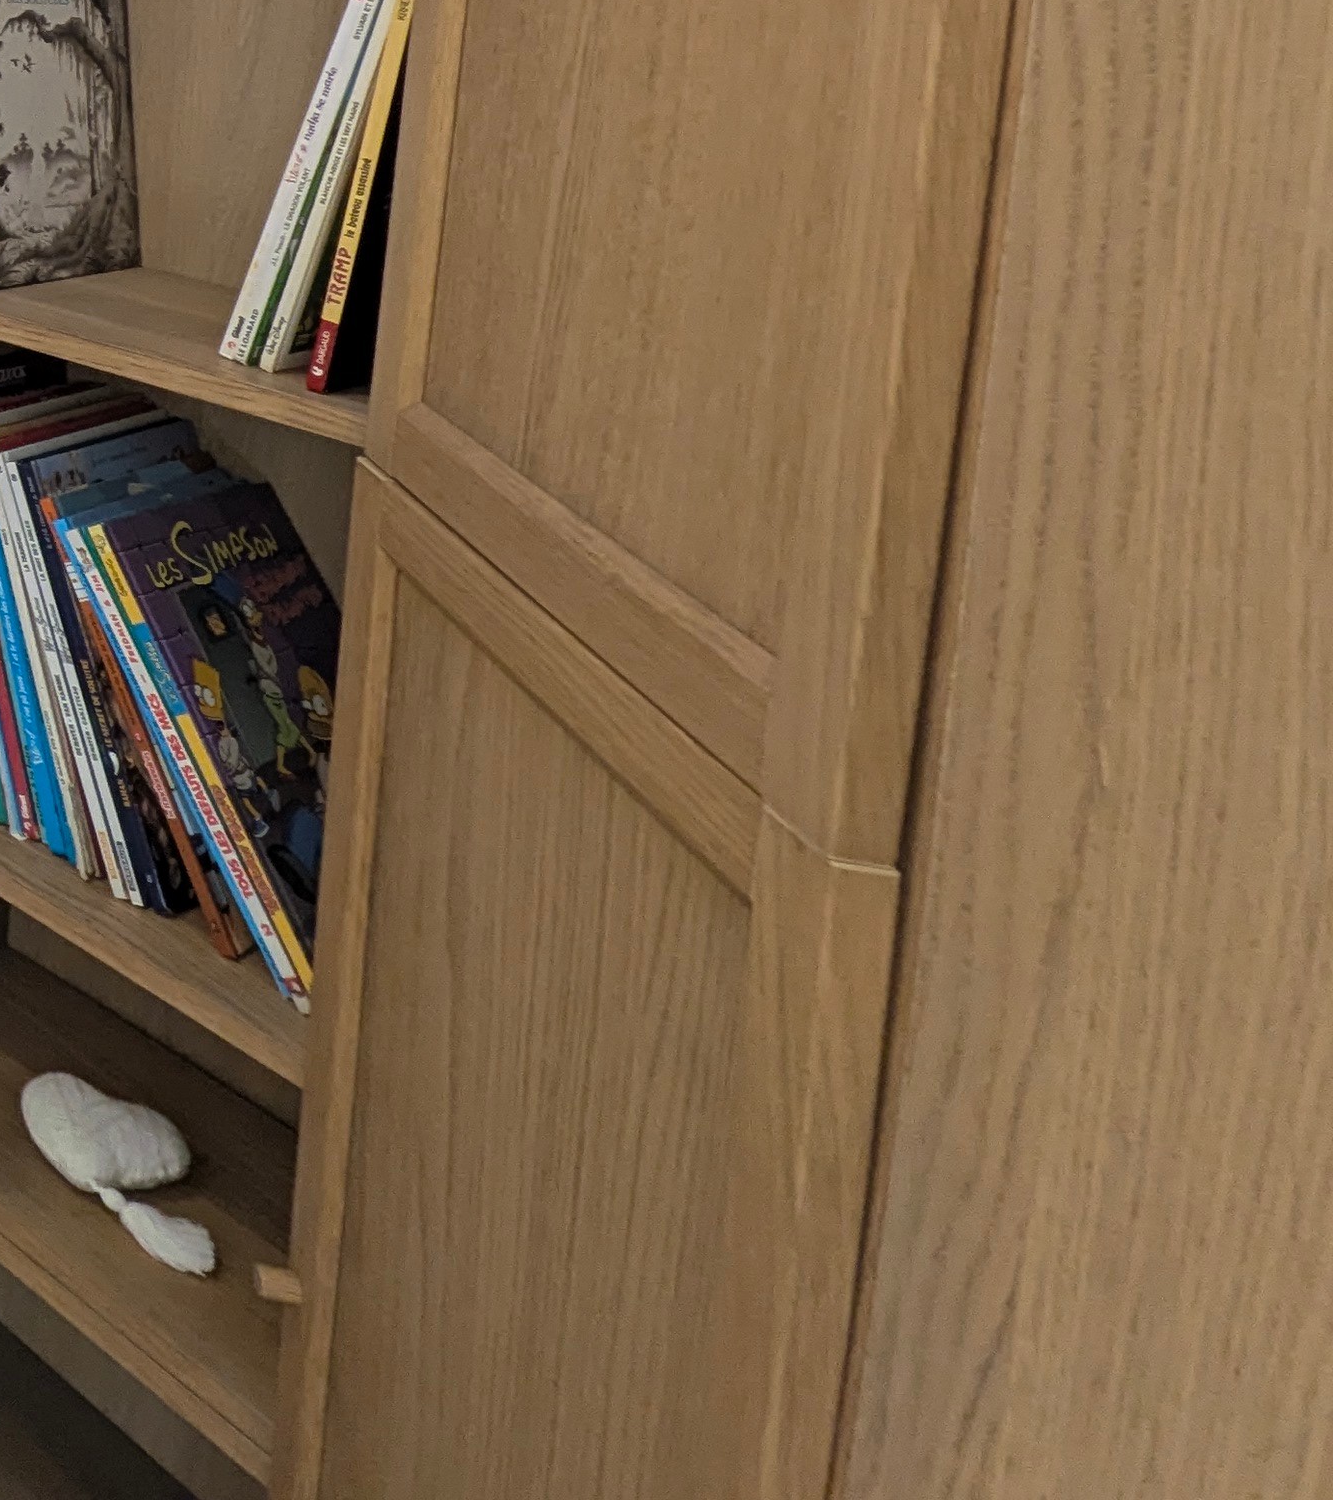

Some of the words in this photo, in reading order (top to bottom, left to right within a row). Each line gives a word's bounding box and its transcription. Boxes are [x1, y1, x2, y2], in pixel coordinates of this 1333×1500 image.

[354, 157, 374, 197] assassiné
[345, 198, 363, 228] bateau
[343, 228, 355, 238] le
[324, 245, 354, 306] TRAMP
[240, 307, 260, 348] LOMBARD
[237, 348, 246, 358] LE
[313, 329, 331, 364] DARGAUD
[89, 574, 104, 594] JIM
[145, 557, 183, 588] Les
[108, 612, 139, 665] FREDMAN
[146, 691, 173, 732] MECS
[166, 732, 188, 763] DES
[212, 828, 233, 857] LES
[225, 857, 253, 899] TOUS
